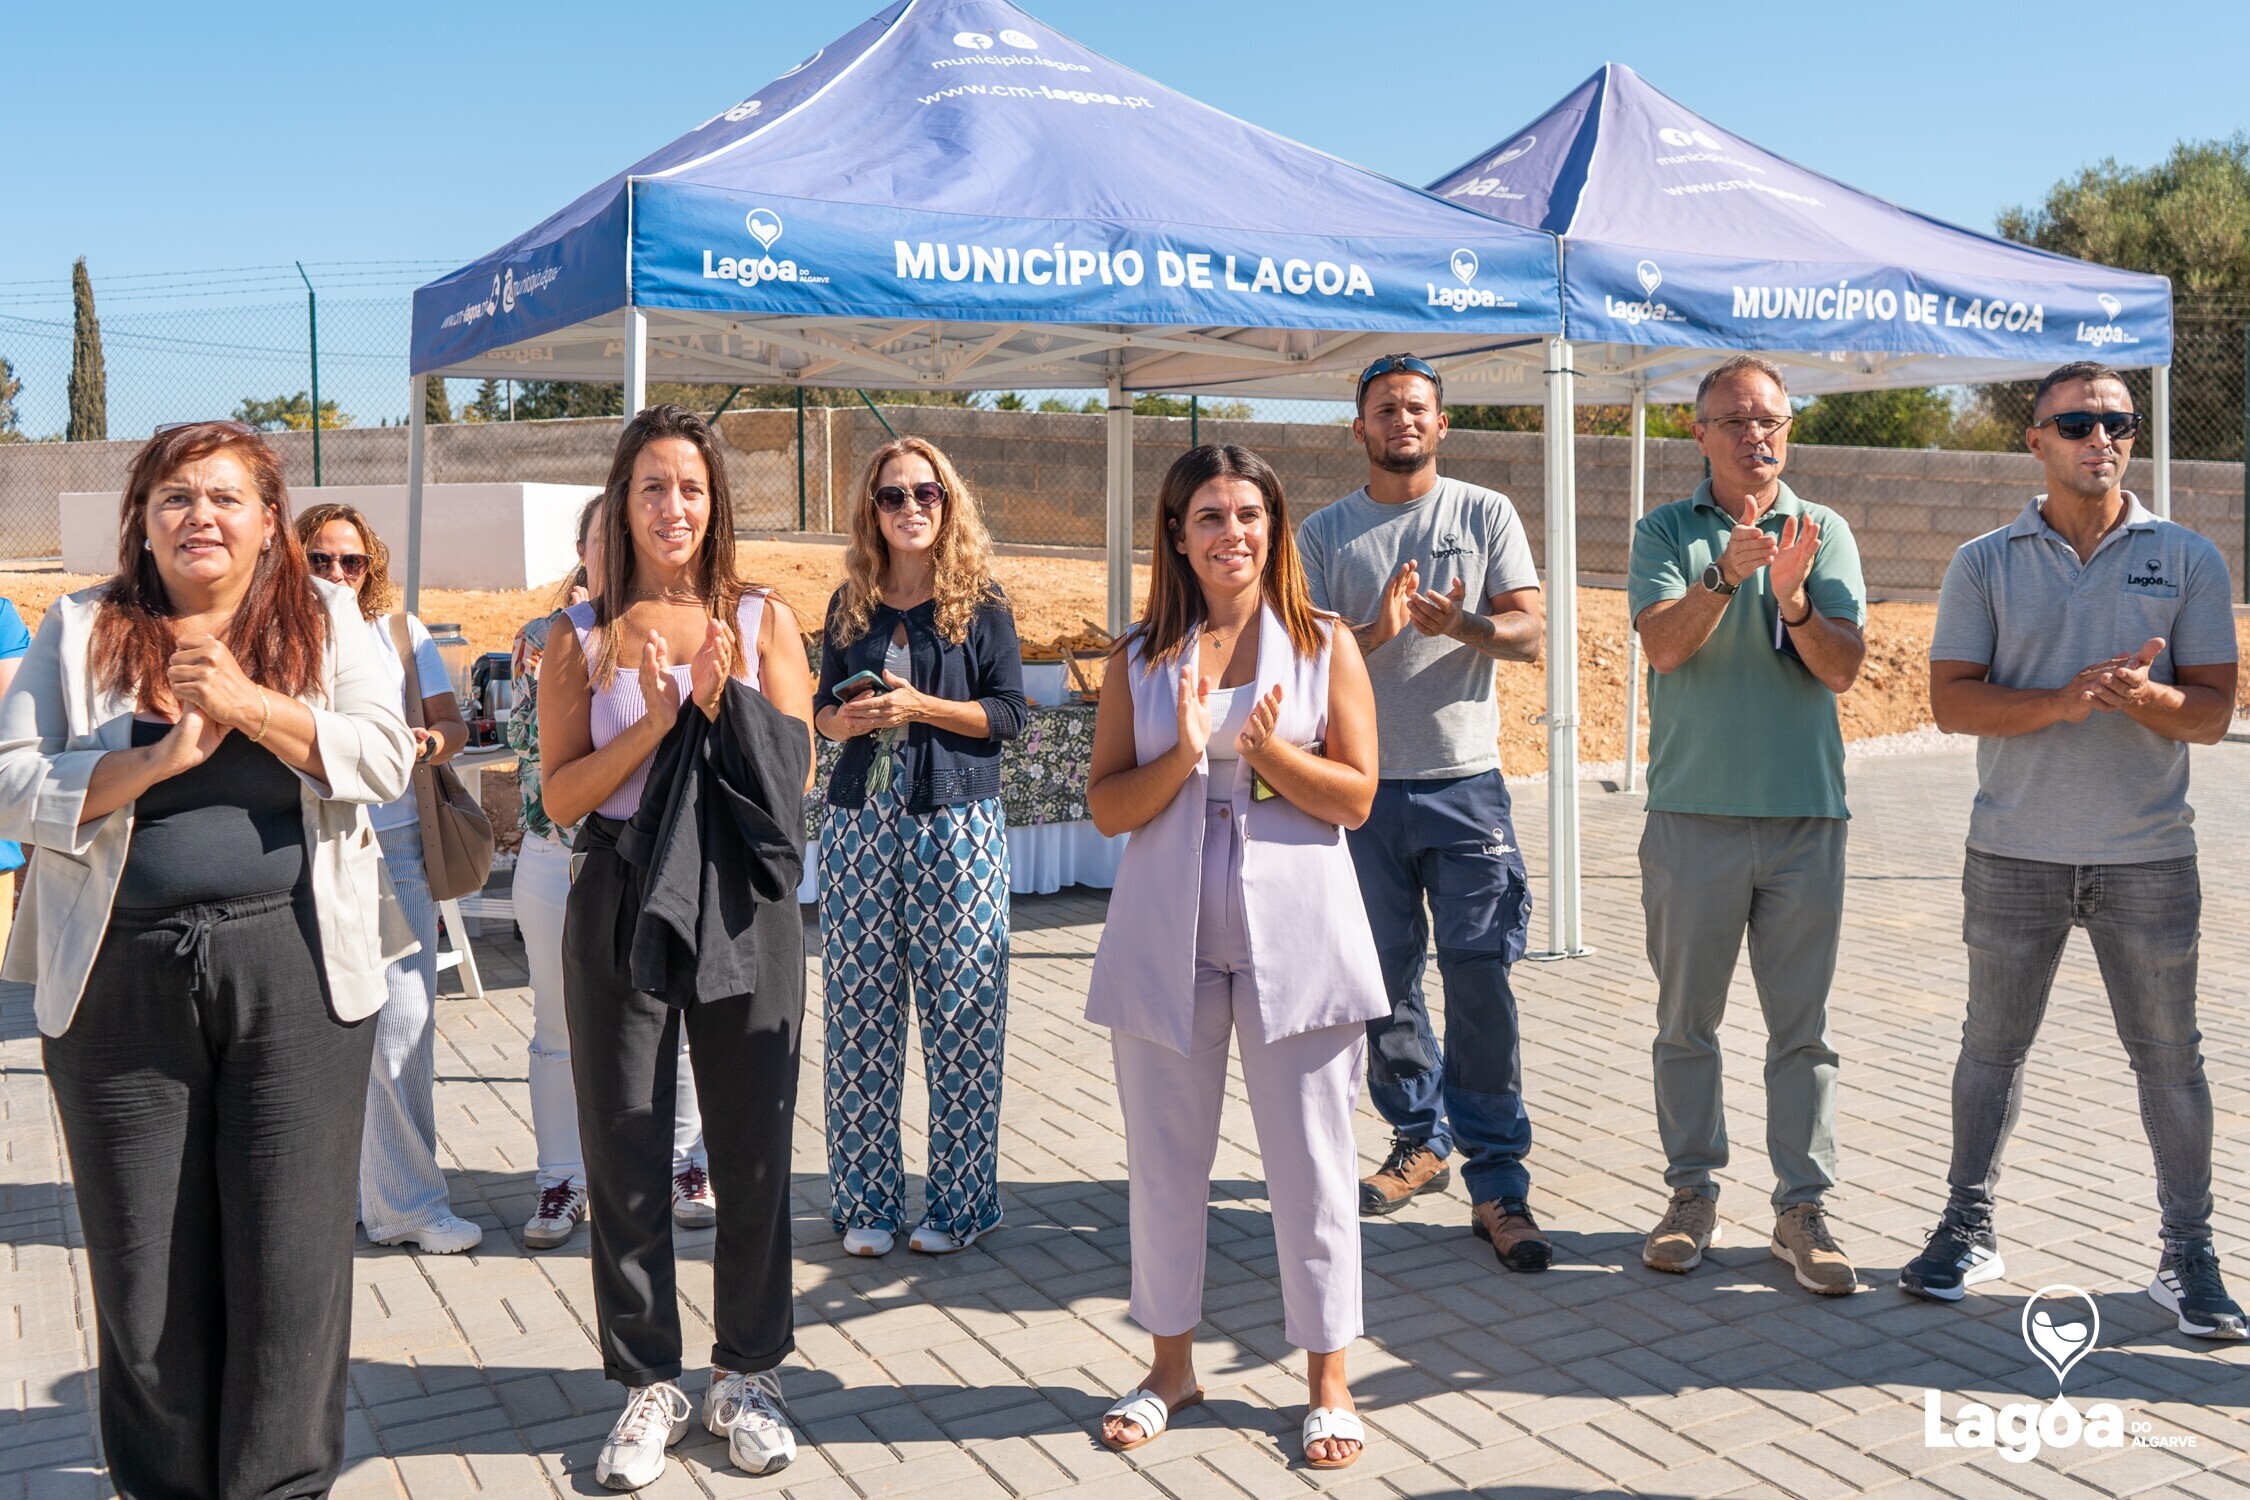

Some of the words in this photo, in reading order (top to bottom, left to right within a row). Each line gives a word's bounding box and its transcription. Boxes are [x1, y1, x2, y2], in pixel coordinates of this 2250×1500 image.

[931, 54, 1092, 72] municipio.lagoa
[917, 84, 1155, 108] www.cm-lagoa.pt
[703, 250, 797, 287] Lagoa
[799, 276, 829, 284] ALGARVE
[894, 240, 1144, 286] MUNICÍPIO
[1157, 250, 1214, 289] DE
[1225, 255, 1375, 296] LAGOA
[1427, 283, 1495, 312] Lagoa
[1605, 295, 1667, 325] Lagoa
[1732, 280, 1897, 320] MUNICÍPIO
[1904, 290, 1939, 325] DE
[1945, 296, 2044, 333] LAGOA
[2076, 321, 2123, 347] Lagoa
[1432, 547, 1461, 558] Lagoa
[2127, 573, 2163, 587] Lagoa
